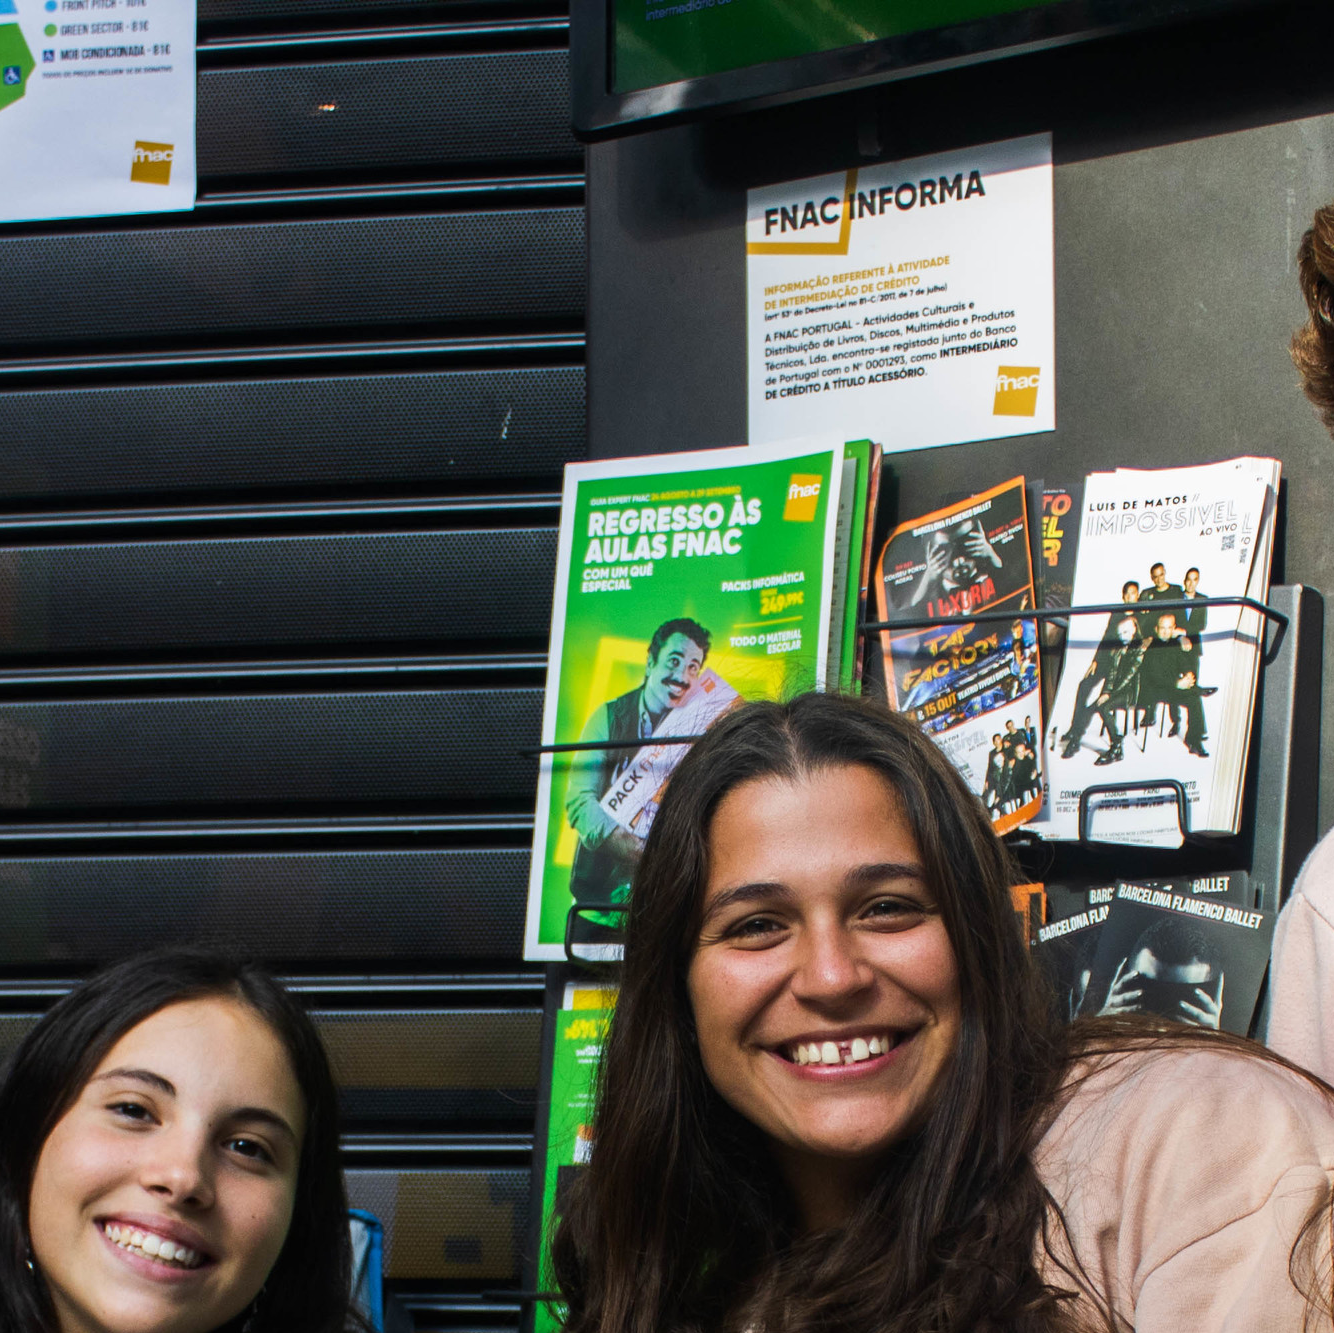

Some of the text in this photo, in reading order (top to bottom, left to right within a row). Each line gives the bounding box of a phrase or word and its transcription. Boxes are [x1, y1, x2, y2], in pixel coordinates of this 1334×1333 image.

[60, 23, 89, 36] GREEN
[133, 146, 175, 164] fnac
[764, 170, 986, 236] FNAC INFORMA
[764, 256, 950, 296] INFORMAÇÃO REFERENTE À ATIVIDADE
[764, 275, 920, 311] DE INTERMEDIAÇÃO DE CRÉDITO
[765, 334, 772, 342] A
[774, 329, 799, 341] FNAC
[802, 320, 852, 336] PORTUGAL
[863, 310, 920, 327] Actividades
[922, 301, 966, 317] Culturais
[968, 302, 975, 310] e
[765, 310, 1016, 358] Distribuição de Livros, Discos, Multimédia e Produtos
[765, 359, 807, 372] Técnicos,
[832, 345, 891, 360] encontra-se
[893, 338, 940, 353] registada
[941, 332, 968, 346] junto
[970, 329, 983, 340] do
[985, 324, 1017, 337] Banco
[766, 376, 778, 386] de
[779, 368, 820, 382] Portugal
[822, 367, 842, 377] com
[910, 352, 938, 363] como
[940, 338, 1018, 358] INTERMEDIÁRIO
[766, 390, 778, 400] DE
[780, 384, 822, 398] CRÉDITO
[824, 382, 830, 391] A
[832, 376, 866, 390] TÍTULO
[996, 374, 1041, 393] fnac
[788, 483, 821, 501] fnac
[1089, 502, 1116, 512] LUIS
[1122, 500, 1138, 510] DE
[1144, 495, 1188, 508] MATOS
[588, 495, 762, 537] REGRESSO ÀS
[1199, 522, 1238, 537] AO VIVO
[584, 528, 742, 564] AULAS FNAC
[583, 562, 654, 581] COM UM QUÊ
[722, 572, 805, 592] PACKS INFORMÁTICA
[582, 580, 632, 594] ESPECIAL
[730, 628, 802, 647] TODO O MATERIAL
[767, 640, 802, 654] ESCOLAR
[924, 622, 976, 657] TAP
[902, 632, 998, 692] FACTORY
[936, 692, 958, 712] OUT
[608, 772, 642, 811] PACK
[1193, 876, 1230, 894] BALLET
[1118, 884, 1172, 908] BARCELONA
[1172, 894, 1225, 922] FLAMENCO
[1225, 908, 1264, 930] BALLET
[1038, 910, 1090, 943] BARCELONA
